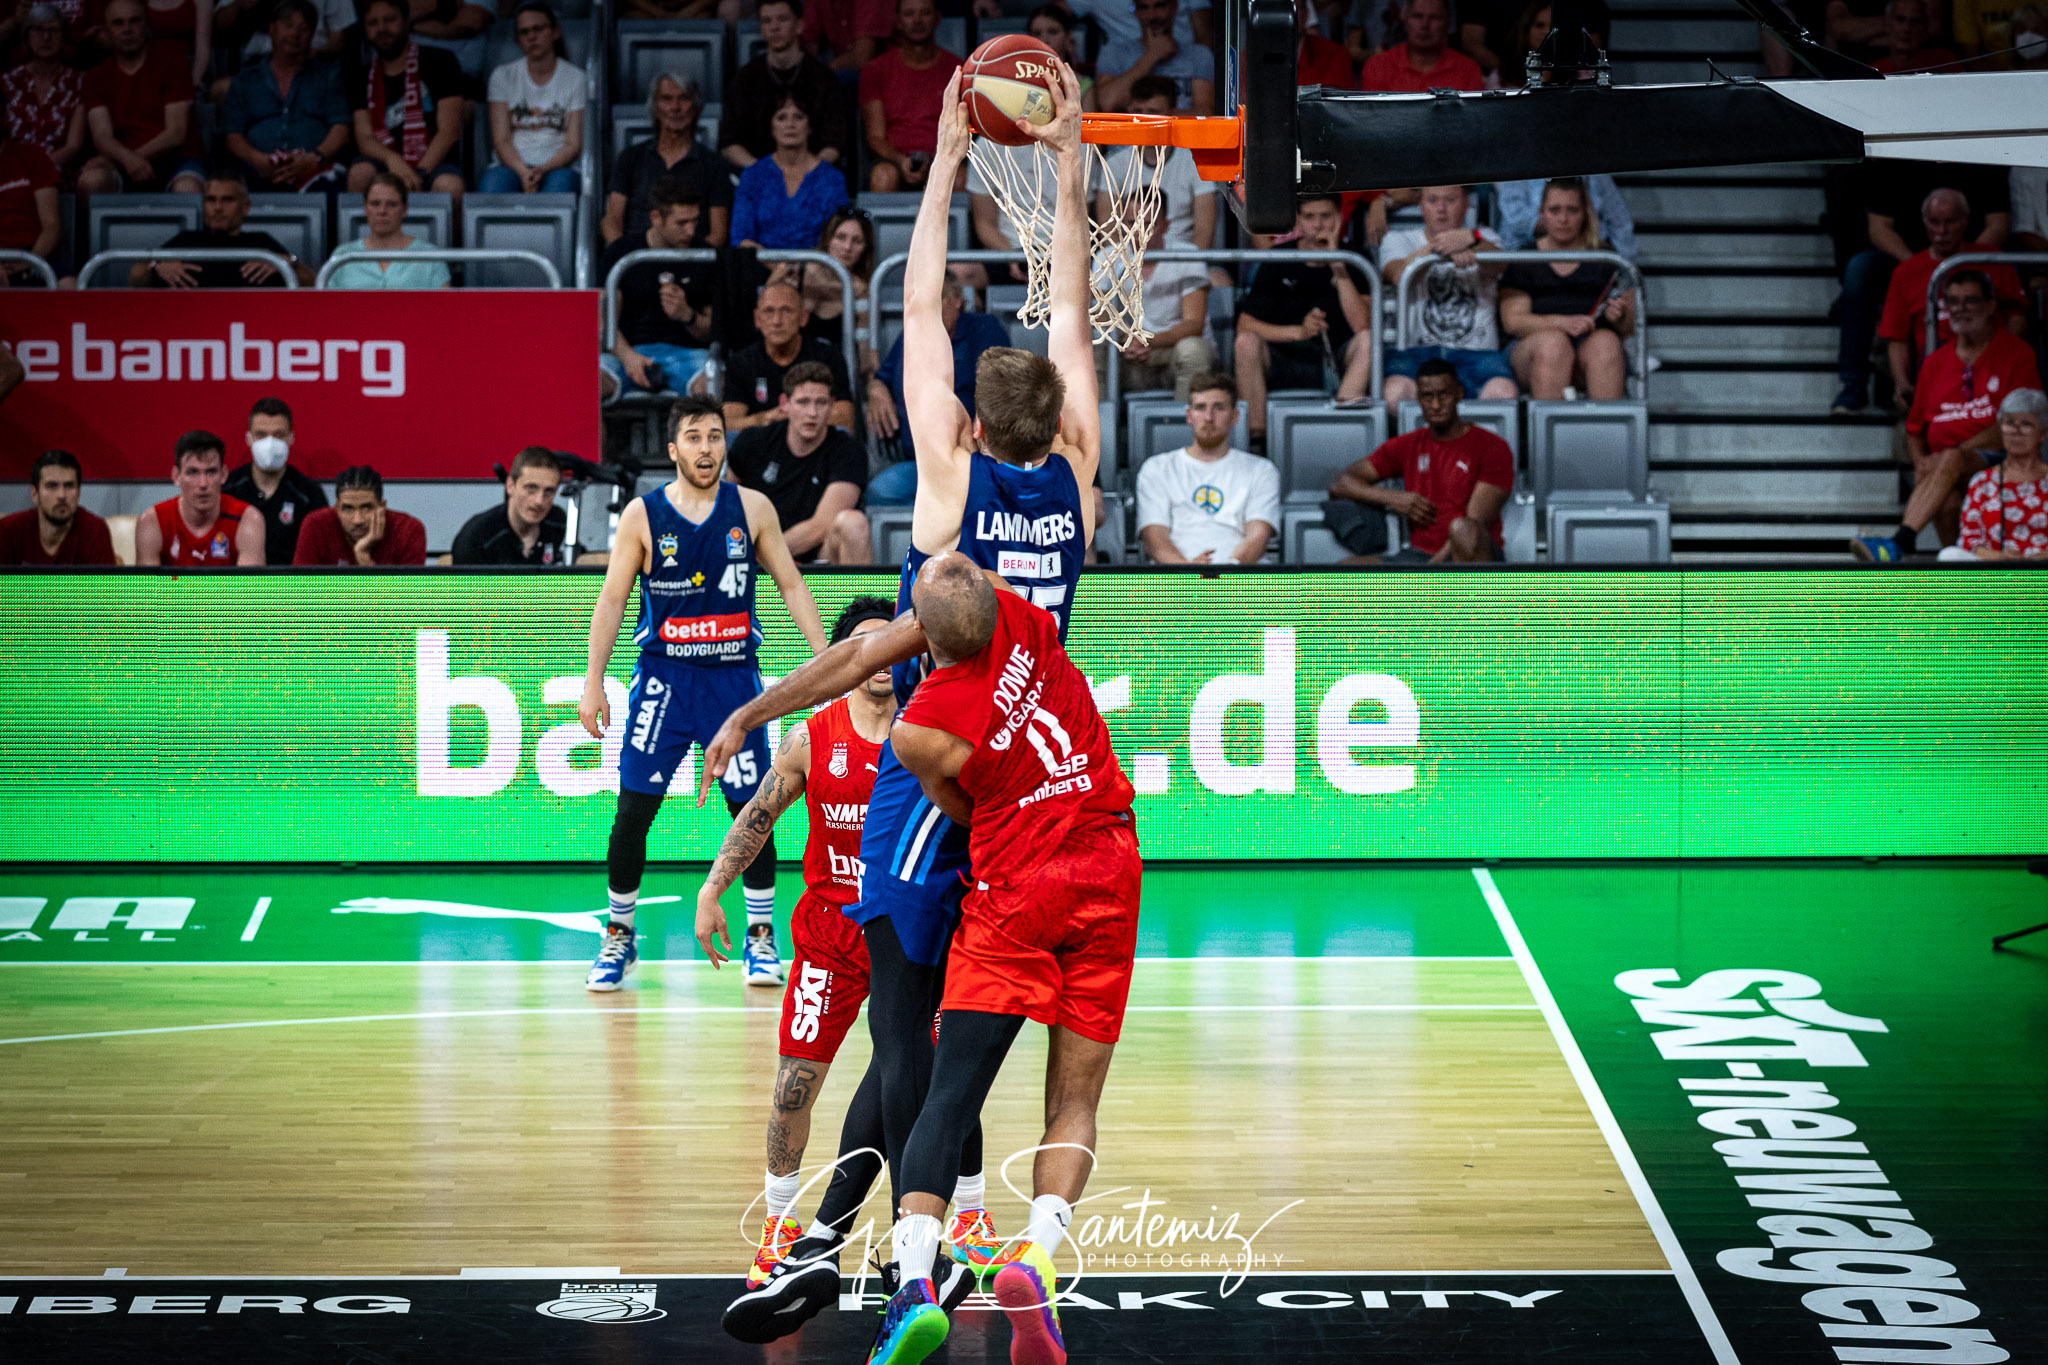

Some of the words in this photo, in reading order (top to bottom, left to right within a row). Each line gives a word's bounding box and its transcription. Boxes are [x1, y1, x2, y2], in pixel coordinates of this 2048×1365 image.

[2, 340, 60, 381] e
[72, 322, 406, 397] bamberg
[976, 511, 1075, 546] LAMMERS
[718, 563, 749, 598] 45
[664, 617, 746, 639] bett1.com
[993, 644, 1036, 716] DOWE
[630, 700, 659, 752] ALBA
[723, 749, 758, 789] 45
[823, 996, 831, 1014] rent
[0, 1295, 411, 1314] BERG
[1256, 1290, 1564, 1309] CITY
